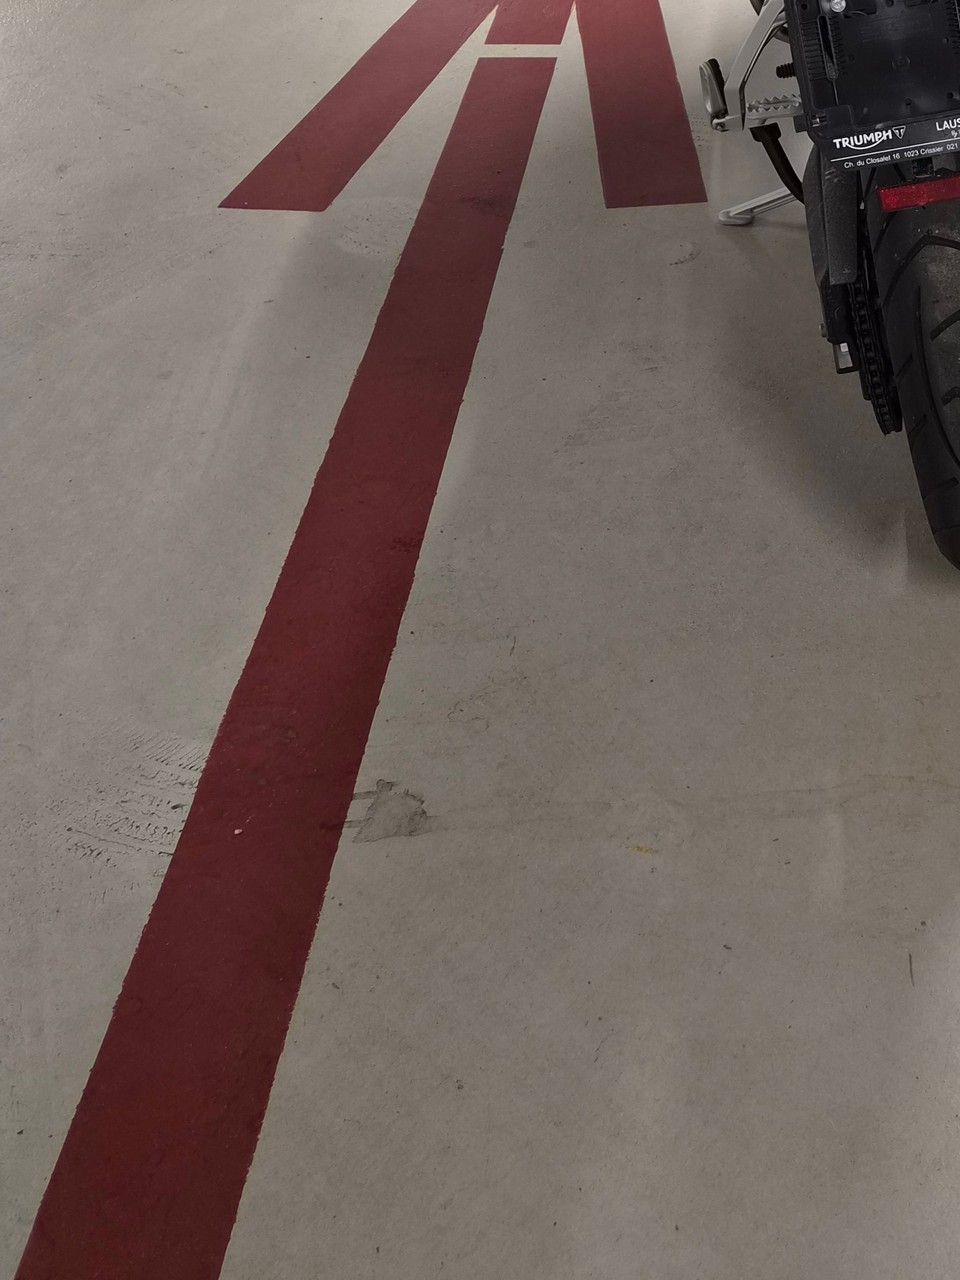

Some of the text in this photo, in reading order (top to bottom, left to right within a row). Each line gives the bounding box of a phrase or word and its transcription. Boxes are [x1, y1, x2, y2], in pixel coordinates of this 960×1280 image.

[832, 129, 893, 150] TRIUMPH
[856, 159, 865, 167] du
[892, 152, 901, 160] 16
[904, 149, 919, 158] 1023
[920, 146, 944, 155] Crissier
[946, 143, 958, 151] 021
